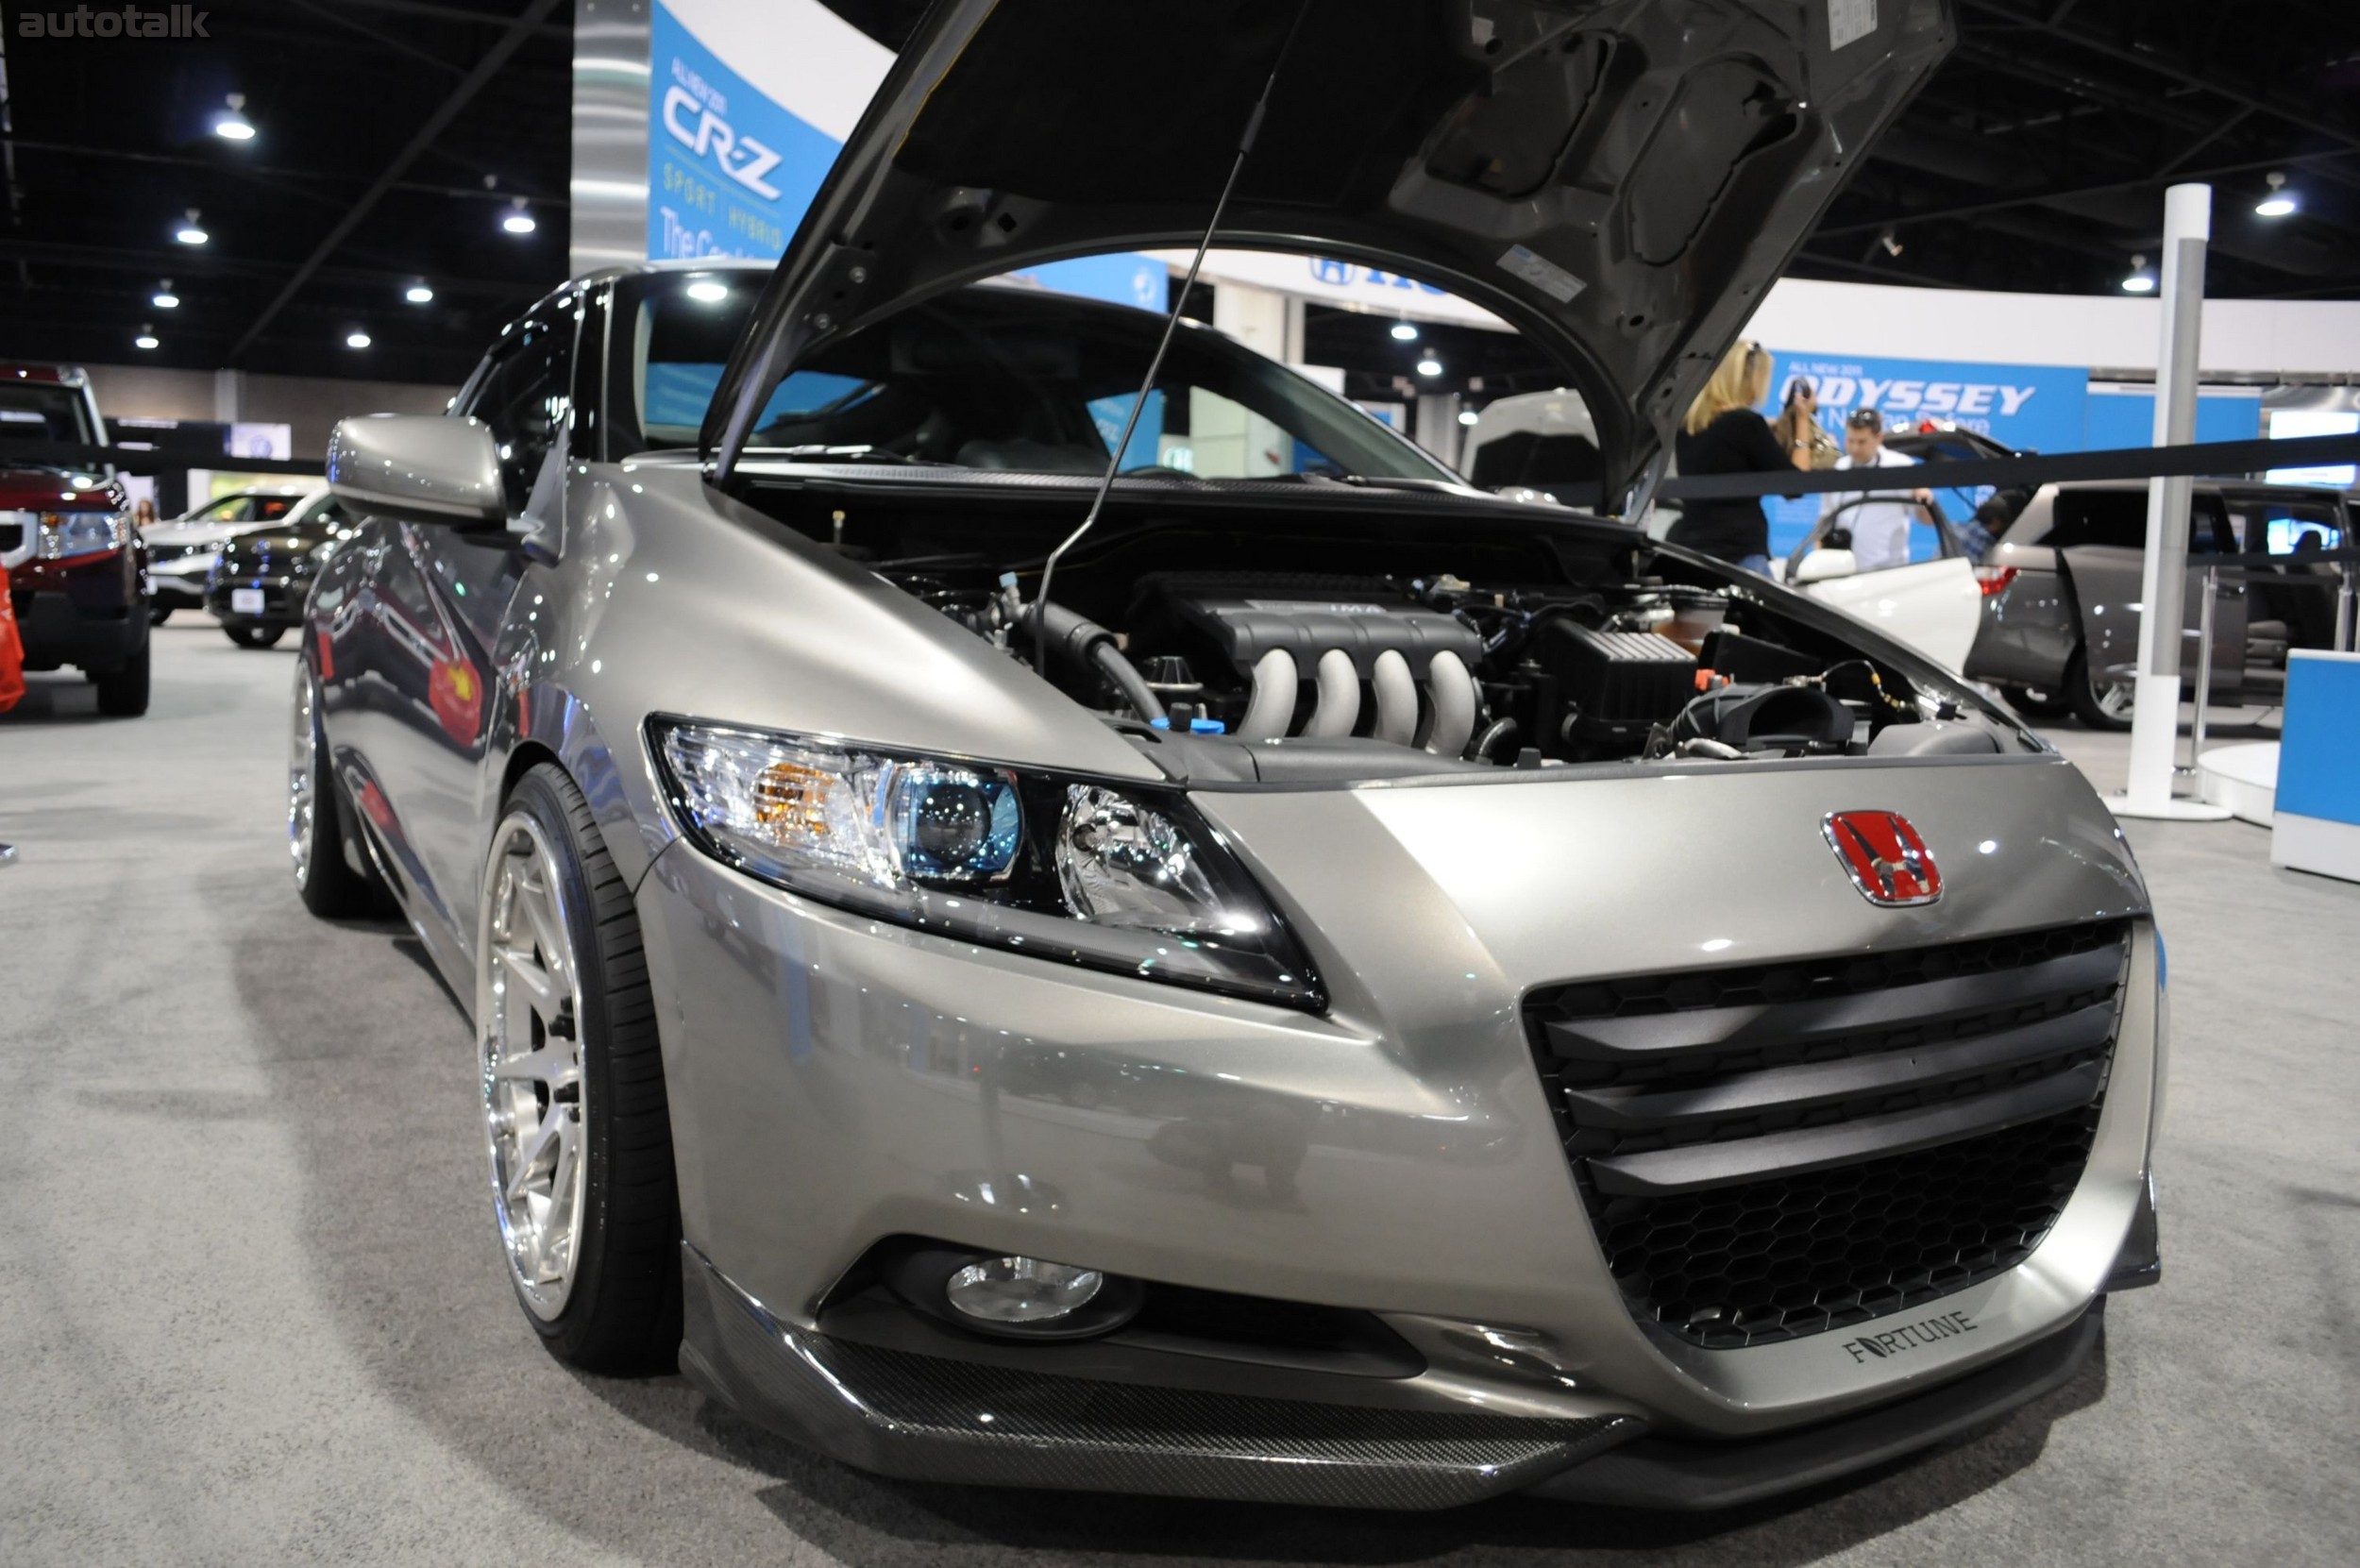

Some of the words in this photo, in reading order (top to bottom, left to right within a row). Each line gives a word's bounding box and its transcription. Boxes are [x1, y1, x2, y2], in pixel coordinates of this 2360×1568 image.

[660, 205, 696, 259] The
[664, 161, 716, 216] SPORT
[728, 206, 784, 251] HYBRID
[1778, 374, 2036, 416] ODYSSEY
